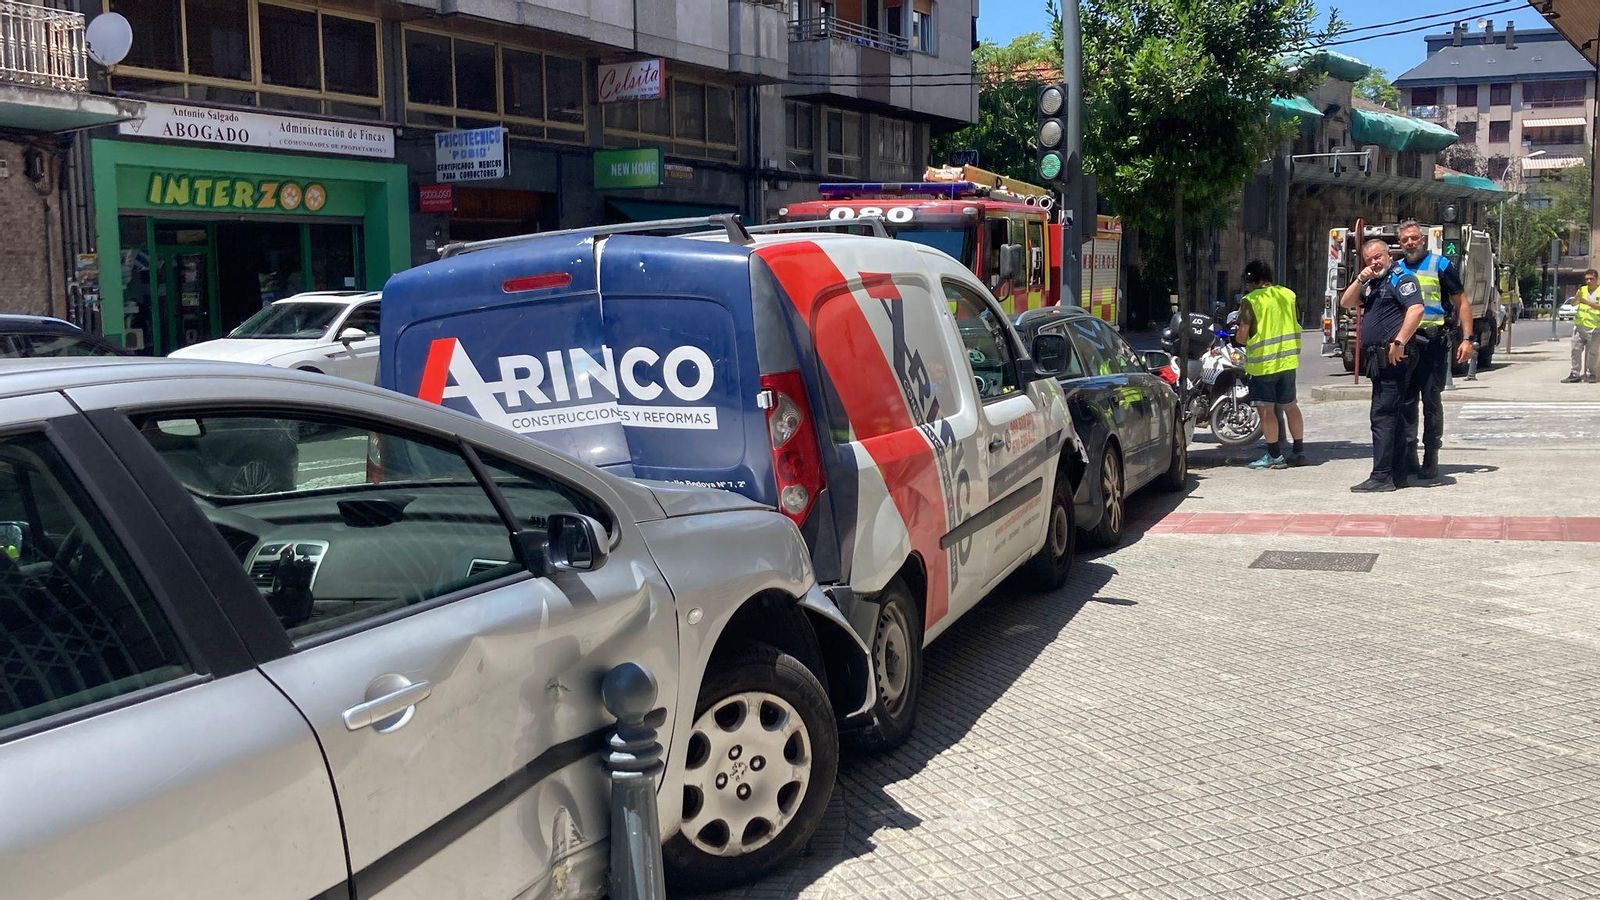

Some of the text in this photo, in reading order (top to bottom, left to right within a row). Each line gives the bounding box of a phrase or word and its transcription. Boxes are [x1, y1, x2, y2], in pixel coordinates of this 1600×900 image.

[600, 64, 658, 99] Celsita
[172, 107, 240, 123] Antonio Salgado
[163, 122, 249, 143] ABOGADO
[280, 122, 386, 142] Administración de Fincas
[438, 130, 500, 147] PSICOTECNICO
[612, 163, 629, 176] NEW
[632, 161, 656, 174] HOME
[150, 175, 326, 211] INTERZOO
[830, 207, 914, 222] 080
[1191, 317, 1203, 325] 07
[1191, 327, 1203, 335] PL
[418, 337, 715, 424] ARINCO
[512, 407, 712, 429] CONSTRUCCIONES Y REFORMAS
